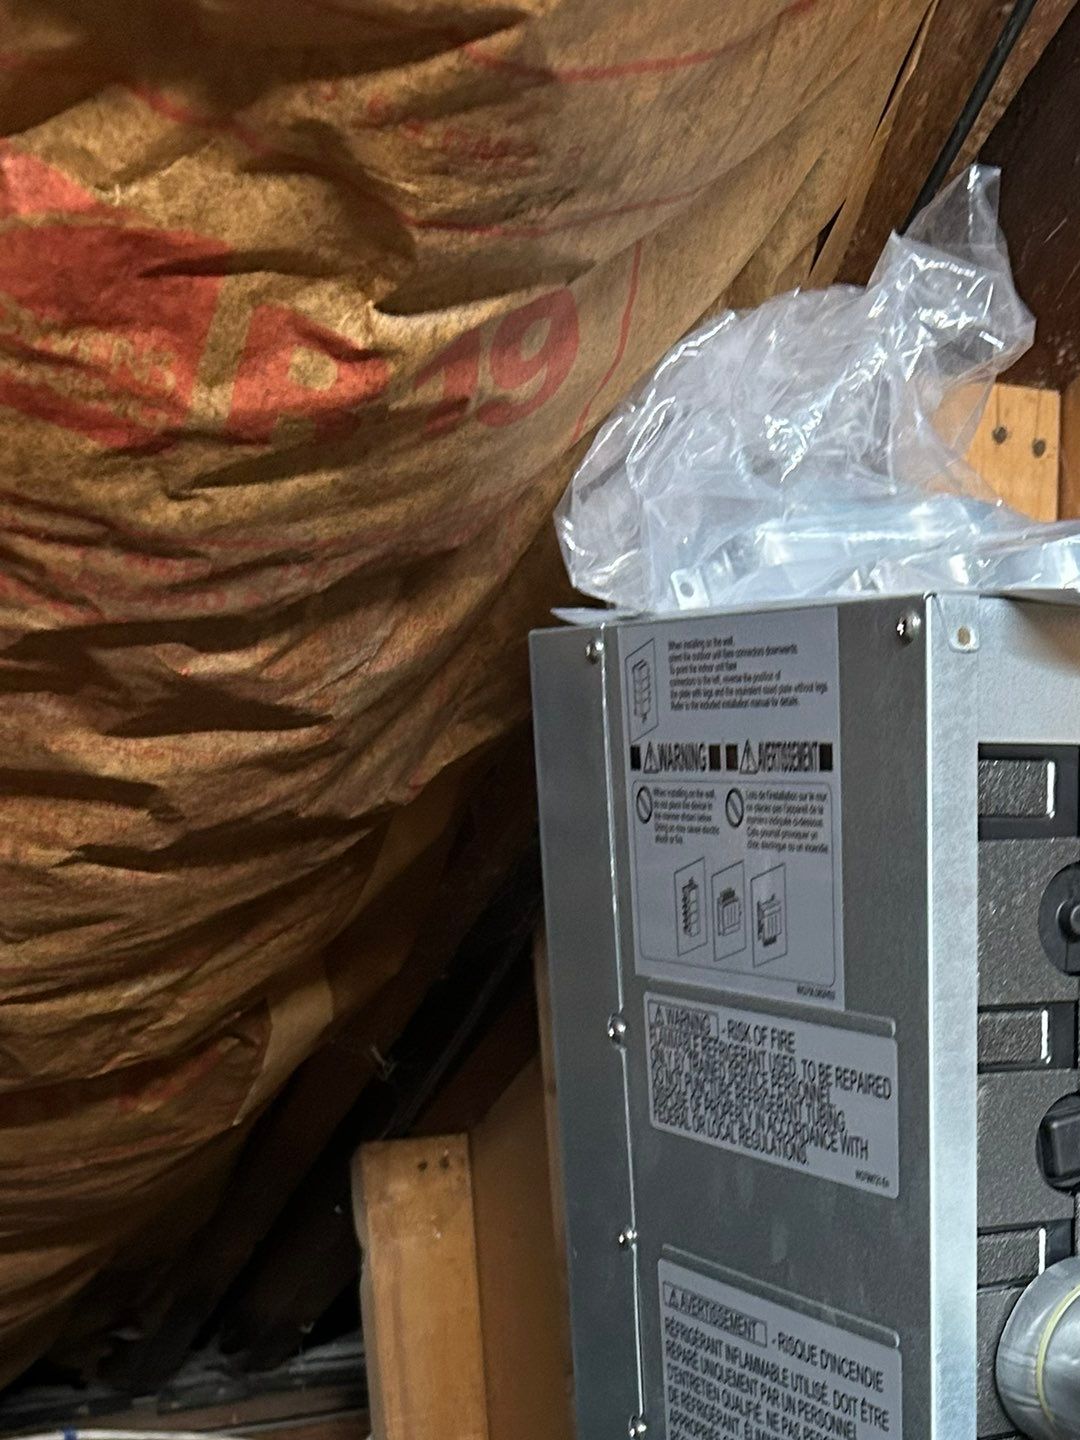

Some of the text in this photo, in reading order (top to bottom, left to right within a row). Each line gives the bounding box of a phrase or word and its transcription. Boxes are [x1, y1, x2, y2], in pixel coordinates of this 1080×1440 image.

[657, 743, 707, 771] WARNING
[666, 1004, 710, 1036] WARNING
[728, 1018, 751, 1045] RISK
[754, 1024, 768, 1048] OF
[771, 1027, 795, 1055] FIRE
[801, 1058, 816, 1083] TO
[819, 1062, 832, 1088] BE
[835, 1065, 891, 1102] REPAIRED
[840, 1132, 869, 1162] WITH
[679, 1291, 755, 1342] AVERTISSEMENT
[777, 1329, 817, 1367] RISQUE
[819, 1346, 883, 1394] D'INCENDIE
[667, 1384, 679, 1407] DE
[760, 1380, 780, 1410] PAR
[781, 1390, 796, 1417] UN
[832, 1387, 858, 1420] DOIT
[765, 1407, 780, 1434] NE
